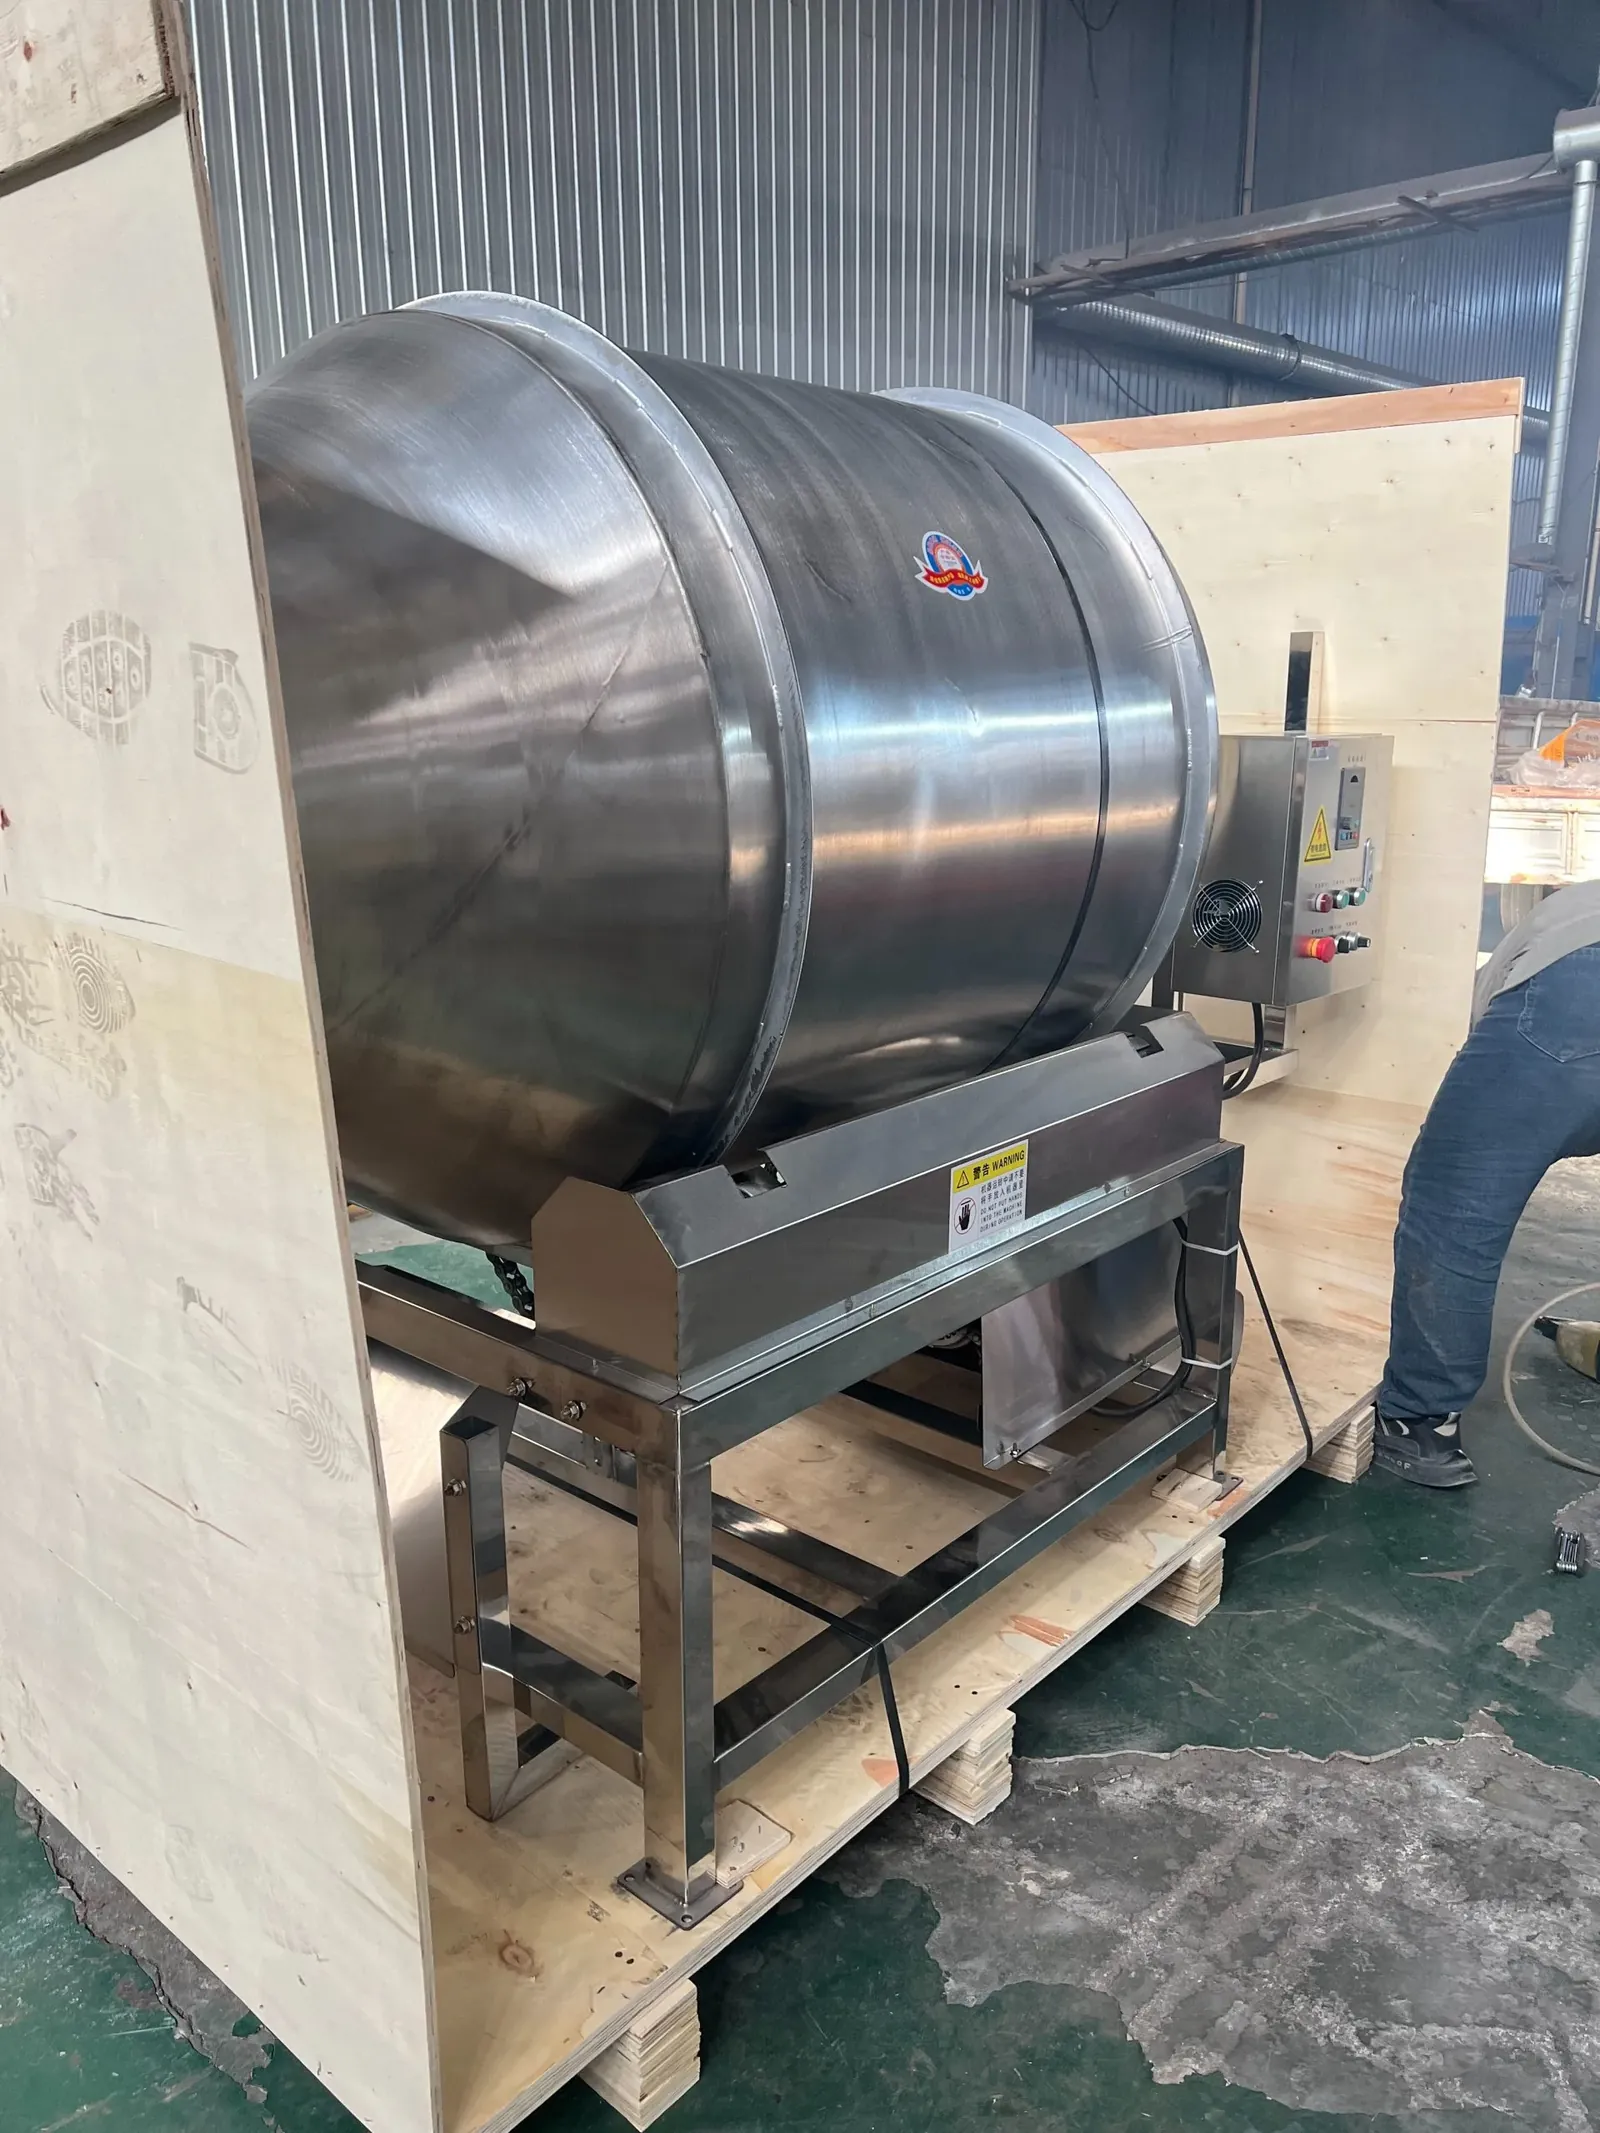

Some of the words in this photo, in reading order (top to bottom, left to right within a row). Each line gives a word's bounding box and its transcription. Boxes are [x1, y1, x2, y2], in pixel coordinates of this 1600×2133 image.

[973, 1163, 990, 1181] 警告
[992, 1150, 1025, 1171] WARNING
[980, 1207, 986, 1215] DO
[988, 1203, 996, 1211] NOT
[998, 1198, 1006, 1207] PUT
[1008, 1192, 1022, 1203] HANDS
[980, 1213, 991, 1223] INTO
[993, 1209, 1001, 1217] THE
[1003, 1200, 1022, 1213] MACHINE
[980, 1220, 996, 1232] DURING
[998, 1209, 1022, 1225] OPERATION
